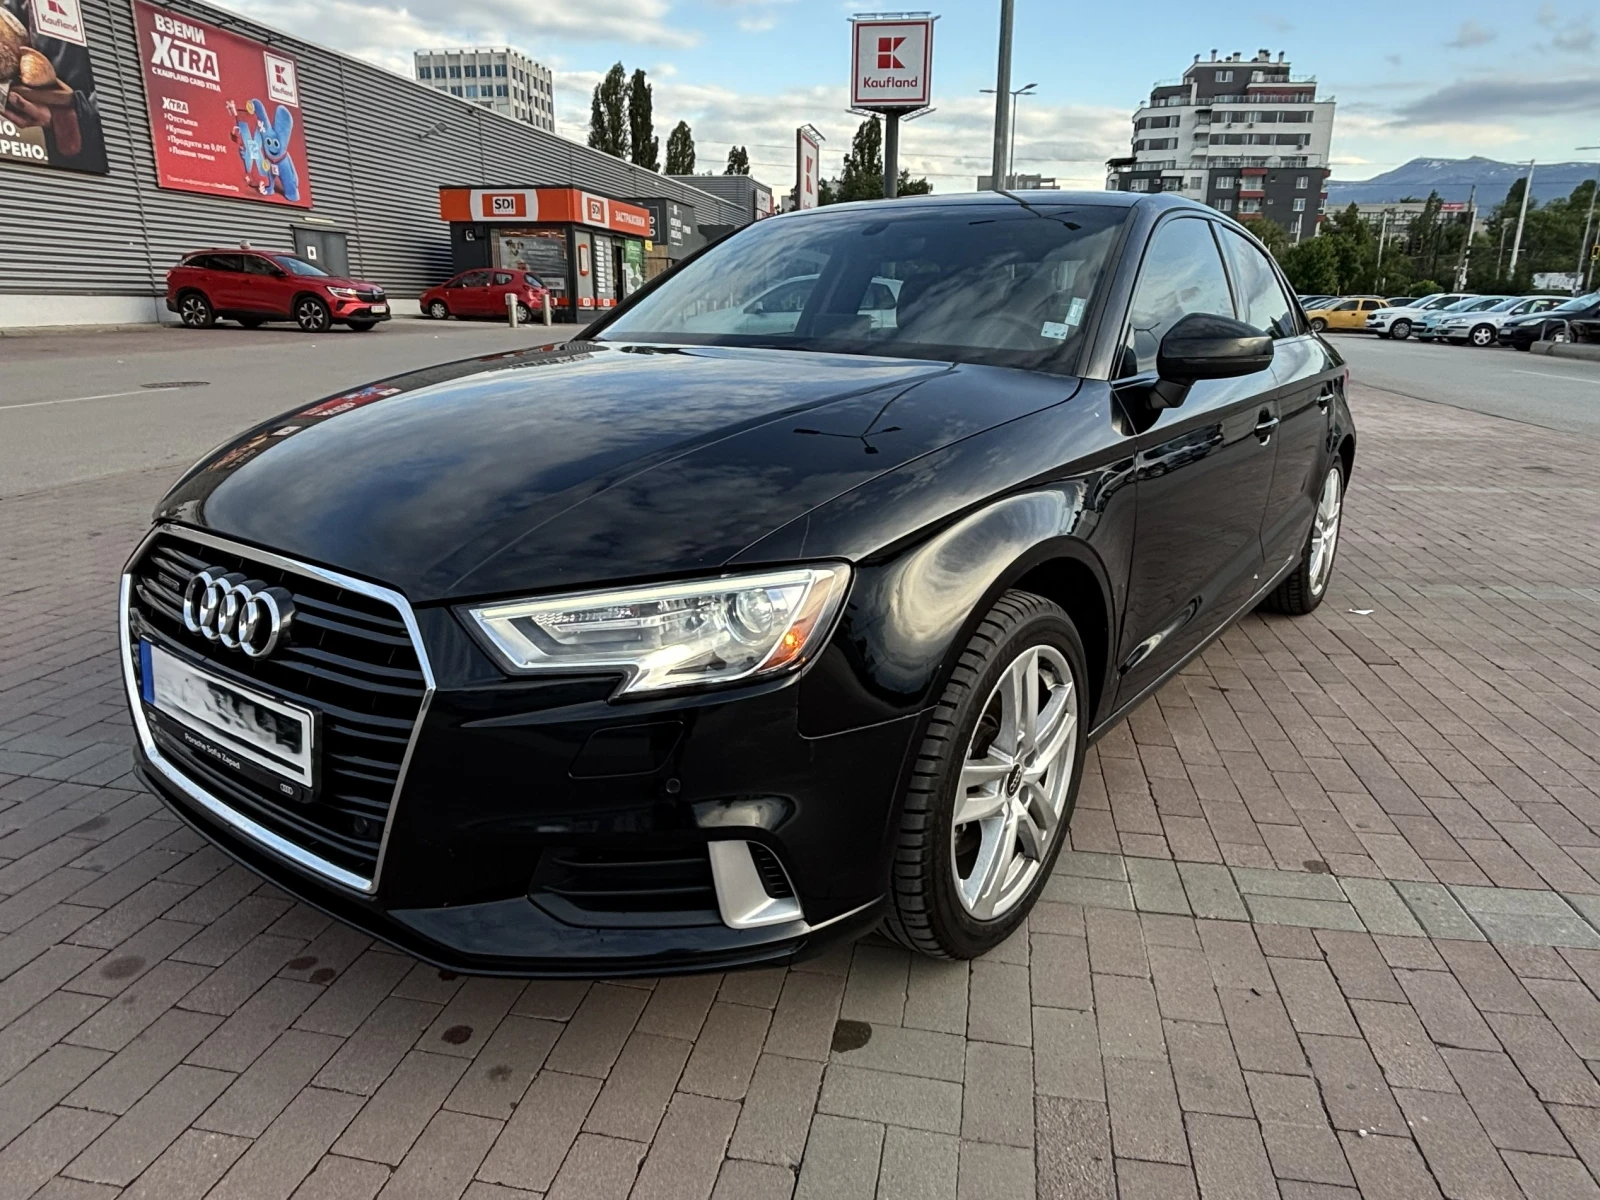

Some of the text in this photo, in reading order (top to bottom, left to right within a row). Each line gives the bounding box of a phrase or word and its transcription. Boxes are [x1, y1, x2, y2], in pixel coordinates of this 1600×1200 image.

[41, 13, 78, 32] Kaufland
[154, 13, 206, 46] ВЗЕМИ
[150, 31, 220, 82] XTRA
[157, 68, 190, 84] KAUFLAND
[189, 77, 206, 88] CARD
[205, 81, 222, 93] XTRA
[863, 76, 918, 88] Kaufland
[271, 84, 294, 98] Kaufland
[162, 96, 190, 115] XTRA
[0, 139, 49, 161] РЕНО.
[494, 198, 514, 210] SDI
[184, 732, 241, 770] Porsche Sofia Zapad
